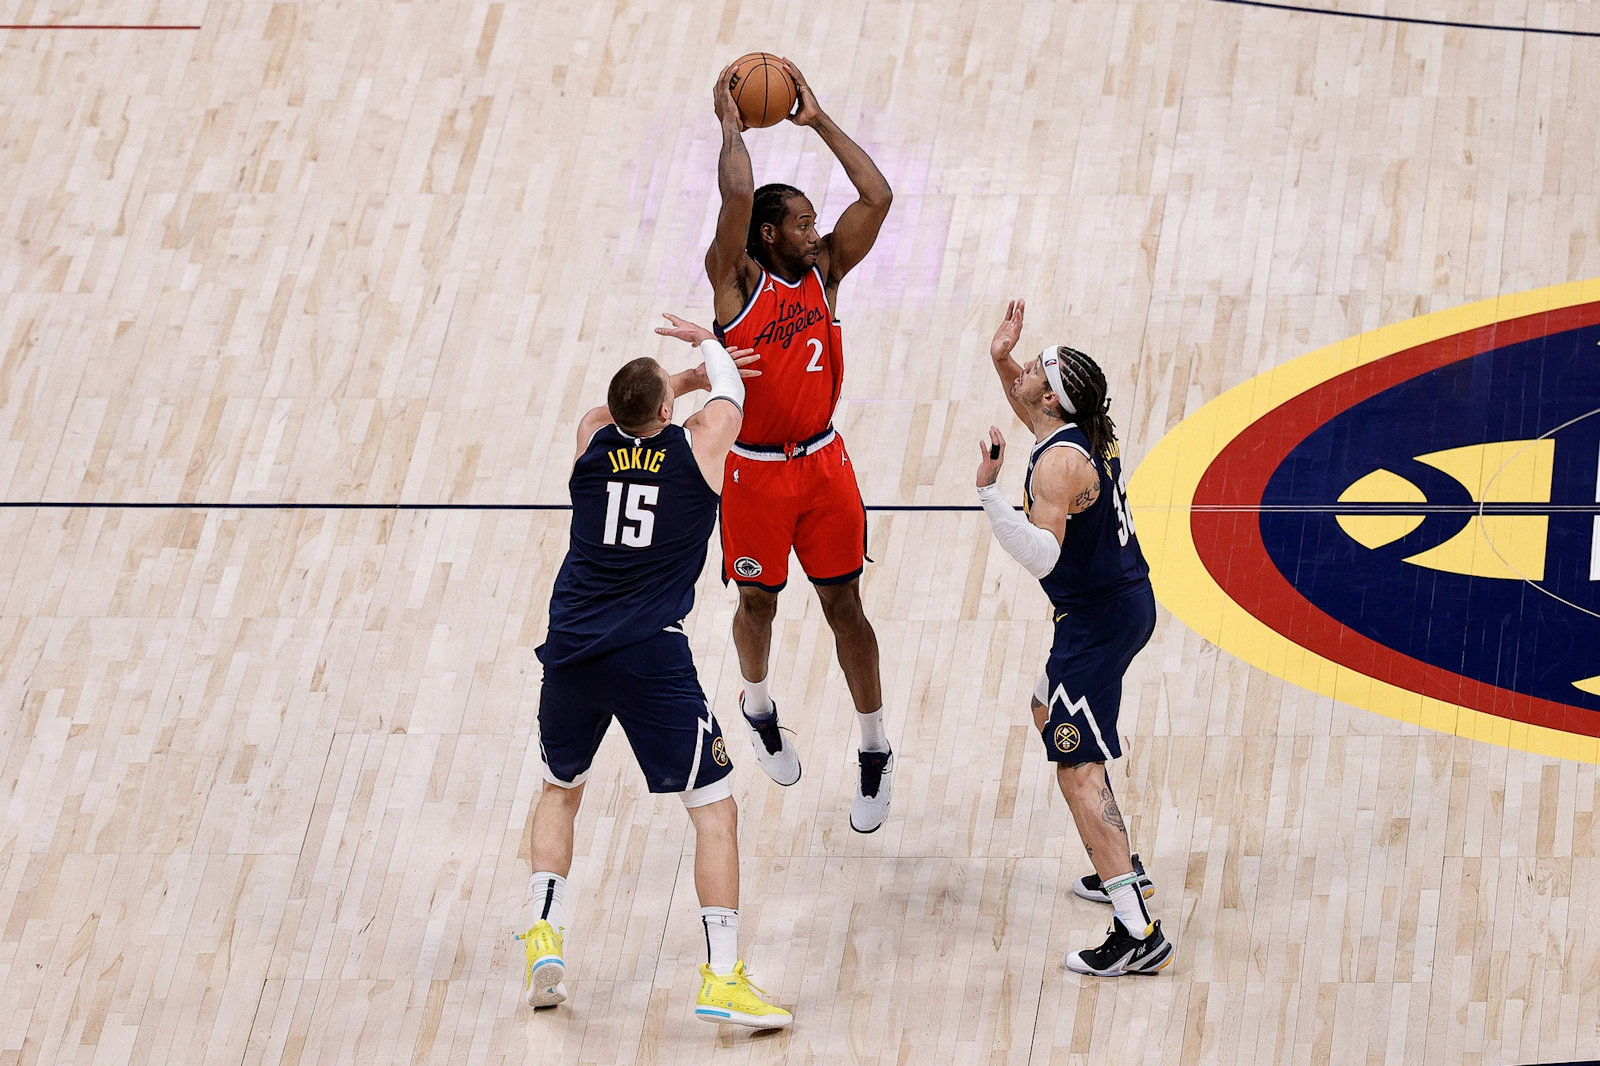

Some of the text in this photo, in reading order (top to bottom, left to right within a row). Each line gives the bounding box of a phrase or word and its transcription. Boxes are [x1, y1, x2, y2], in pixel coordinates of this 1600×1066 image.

[753, 306, 824, 349] Angeles
[778, 299, 805, 323] Los
[806, 338, 824, 372] 2
[608, 447, 667, 473] JOKIĆ
[603, 481, 659, 548] 15
